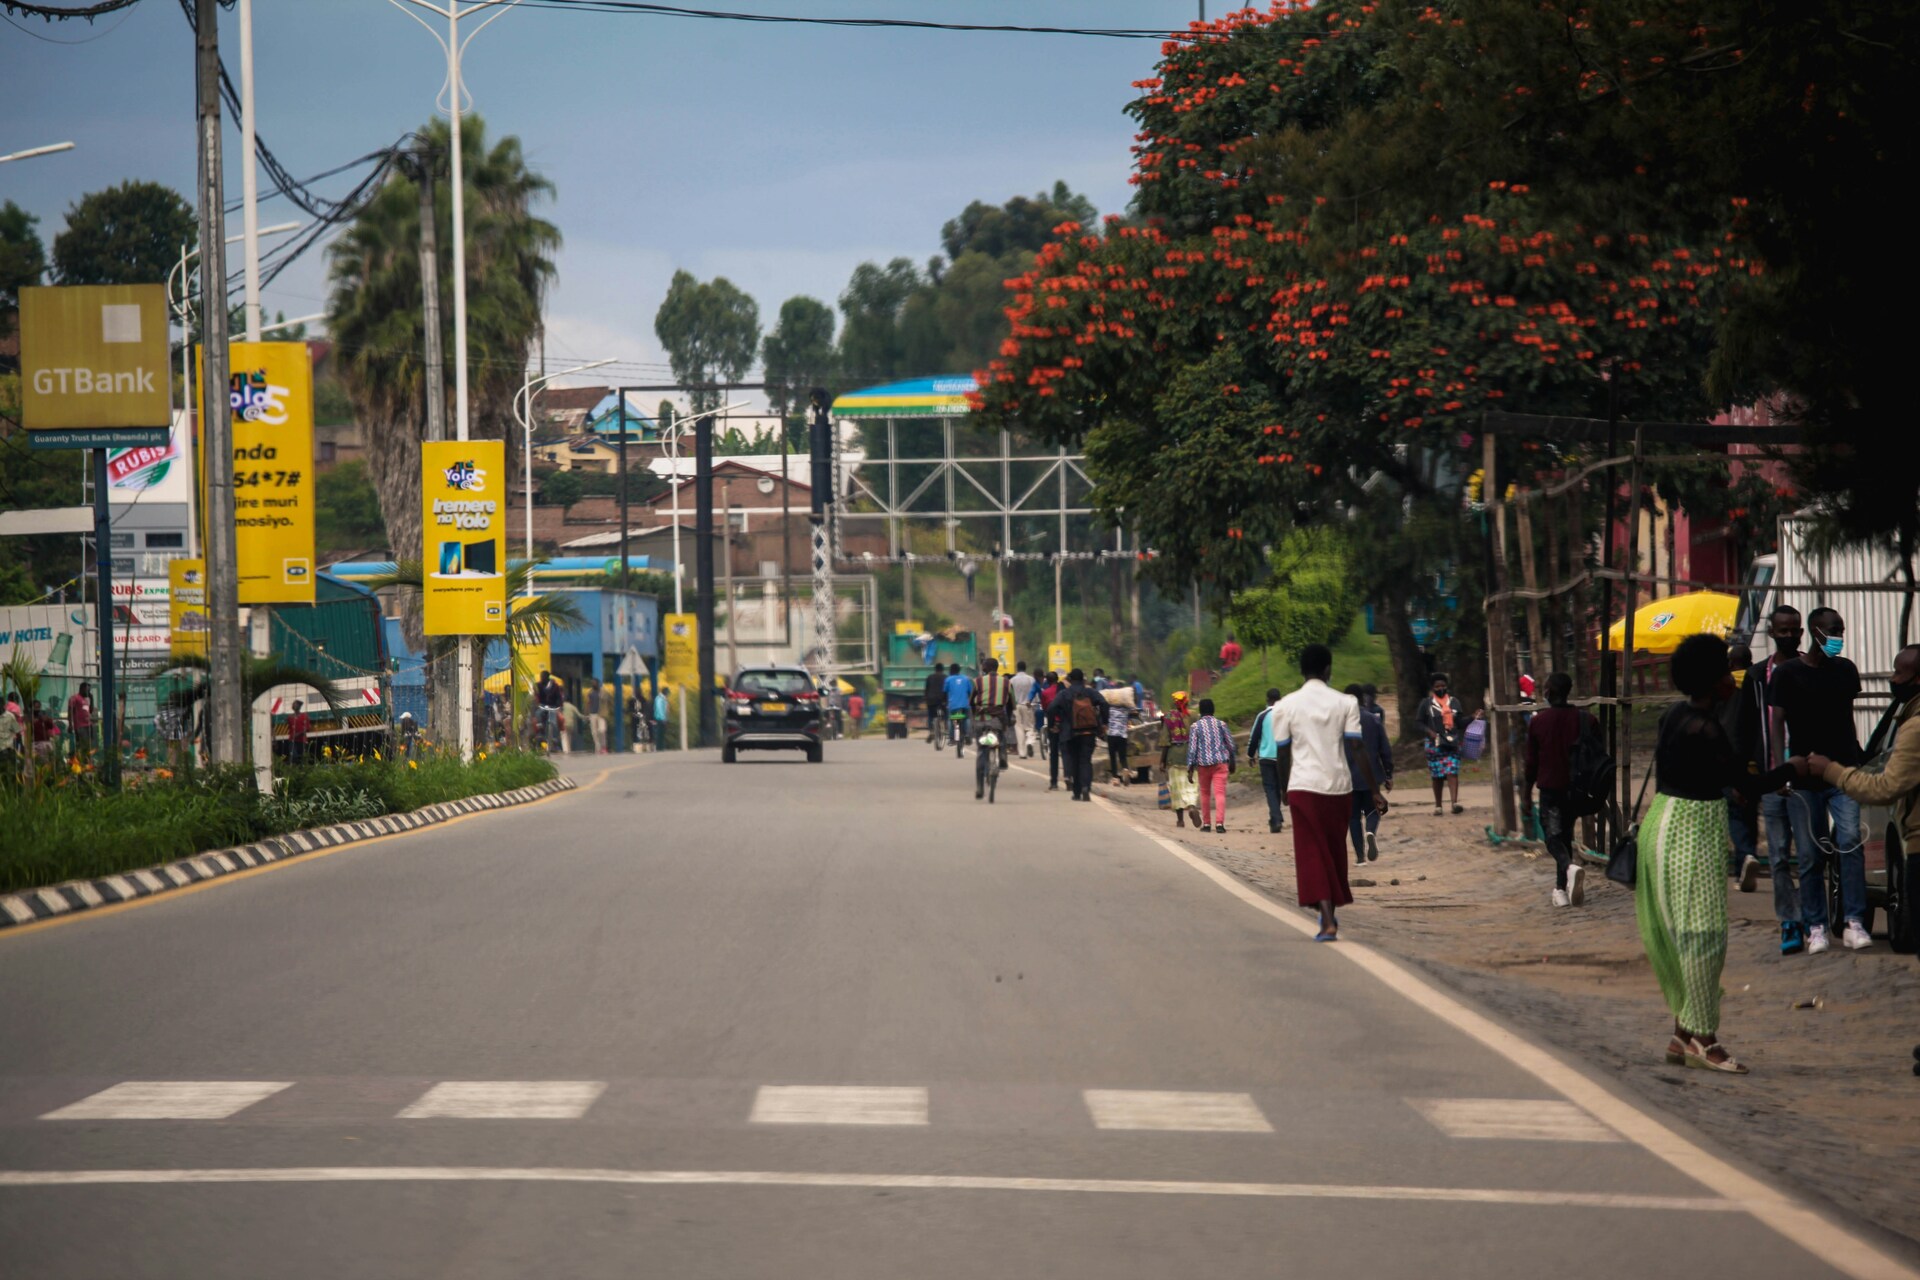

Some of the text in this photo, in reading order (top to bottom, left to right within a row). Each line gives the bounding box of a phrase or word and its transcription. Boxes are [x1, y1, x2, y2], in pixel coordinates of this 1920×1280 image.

[33, 367, 155, 394] GTBank
[34, 431, 162, 444] Guaranty Trust Bank (Rwanda) plc
[234, 443, 277, 460] nda
[115, 446, 166, 474] RUBIS
[442, 469, 476, 482] Yolo
[263, 495, 298, 508] muri
[433, 498, 496, 514] Iremere
[454, 512, 490, 530] Yolo
[112, 584, 143, 596] RUBS
[15, 627, 52, 643] HOTEL
[114, 635, 135, 643] UBS
